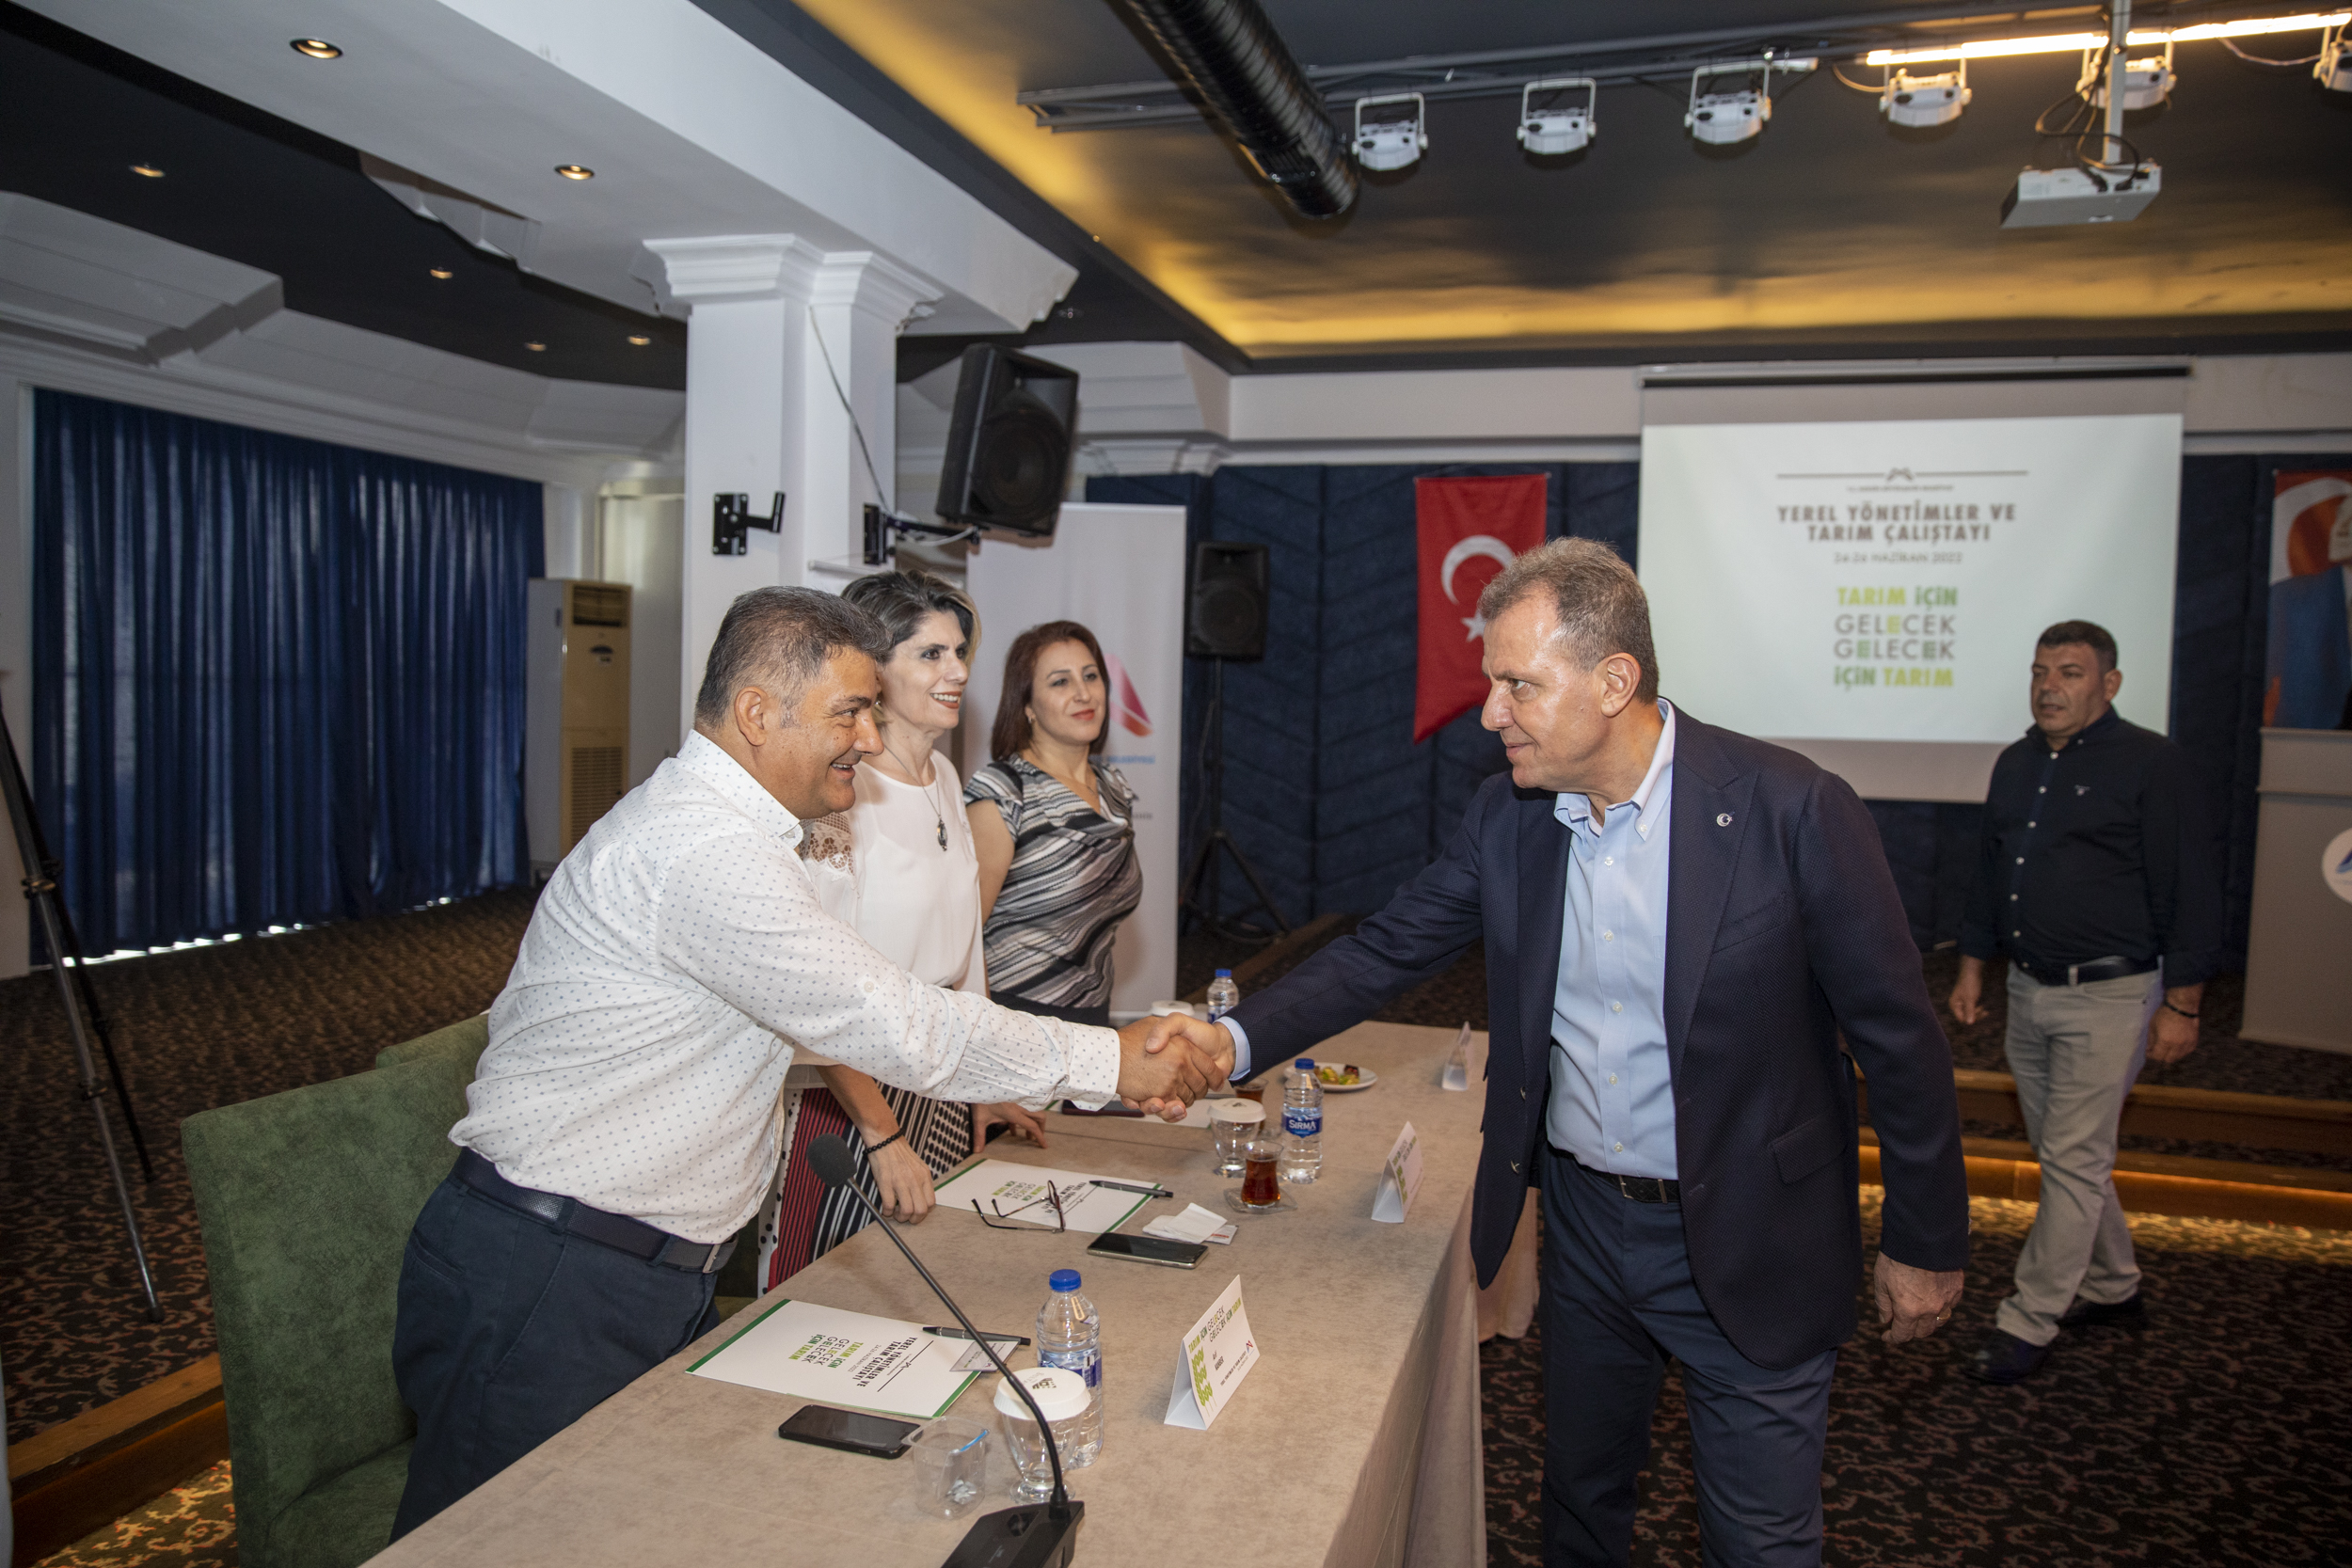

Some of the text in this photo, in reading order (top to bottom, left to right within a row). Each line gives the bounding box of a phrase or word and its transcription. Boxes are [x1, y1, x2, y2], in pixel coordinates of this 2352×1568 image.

[1777, 499, 2016, 522] YEREL YÖNETİMLER VE
[1807, 523, 1991, 546] TARIM ÇALIŞTAYI
[1836, 585, 1959, 611] TARIM İÇİN
[1835, 613, 1957, 636] GELECEK
[1834, 639, 1956, 659] GELECEK
[1834, 666, 1954, 692] İÇİN TARIM
[788, 1344, 814, 1360] TARIM
[802, 1336, 838, 1363] GELECEK
[813, 1338, 850, 1366] GELECEK
[839, 1341, 865, 1357] TARIM
[879, 1340, 902, 1356] TARIM
[898, 1337, 918, 1350] YEREL
[851, 1356, 883, 1381] ÇALIŞTAYI
[866, 1351, 903, 1380] YÖNETİMLER
